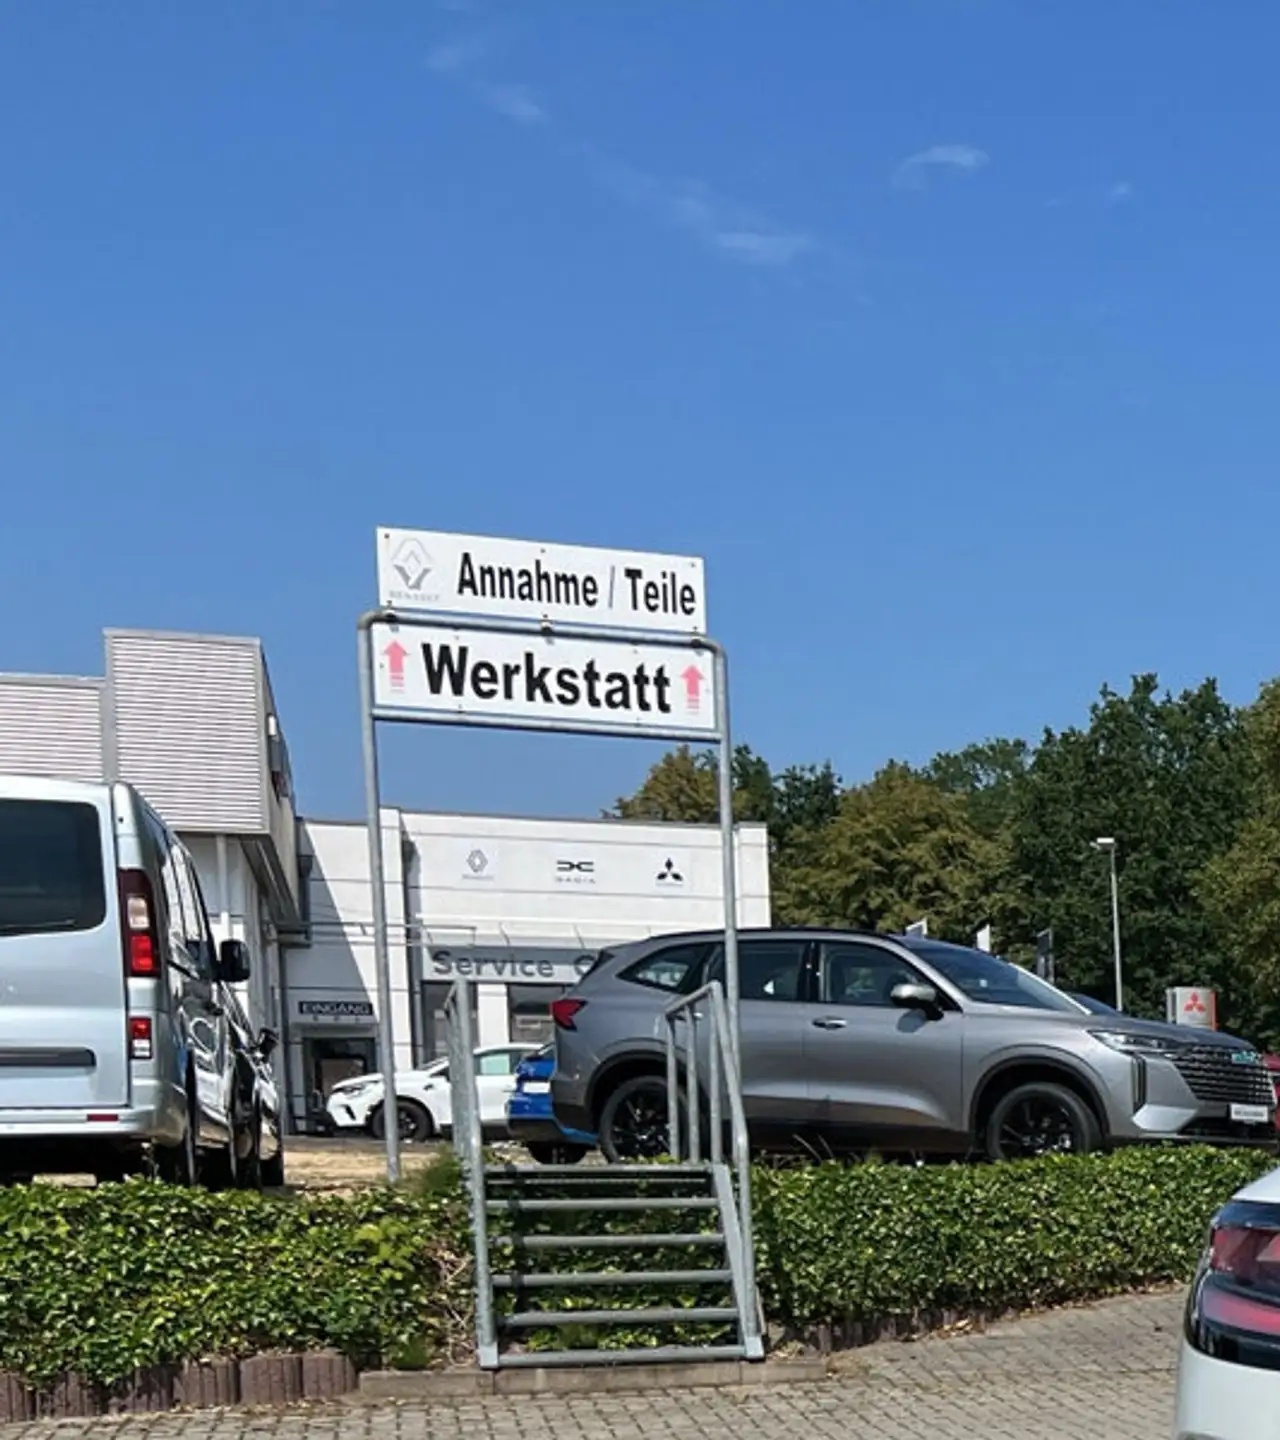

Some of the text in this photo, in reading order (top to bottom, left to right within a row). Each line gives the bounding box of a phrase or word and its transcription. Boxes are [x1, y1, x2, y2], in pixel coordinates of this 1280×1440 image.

[457, 551, 599, 607] Annahme
[624, 567, 696, 616] Teile
[421, 642, 672, 714] Werkstatt
[432, 950, 555, 978] Service
